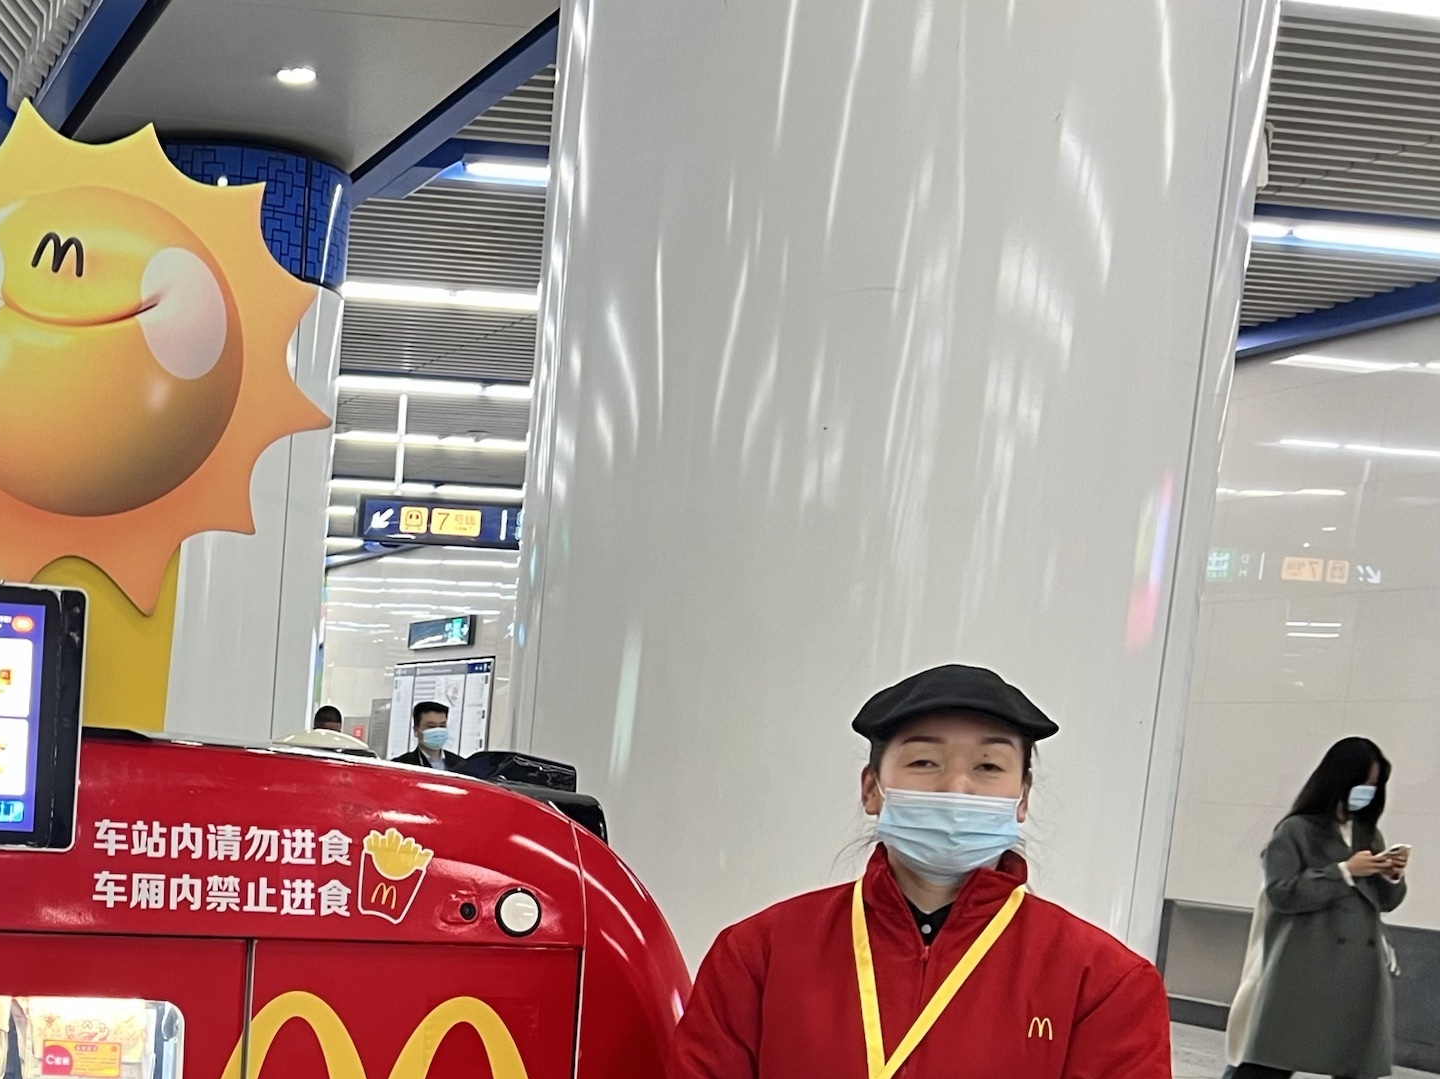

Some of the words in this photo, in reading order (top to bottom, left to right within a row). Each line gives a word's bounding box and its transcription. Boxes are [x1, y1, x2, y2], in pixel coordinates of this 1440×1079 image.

[93, 819, 353, 866] 车站内请勿进食
[92, 871, 352, 918] 车厢内禁止进食
